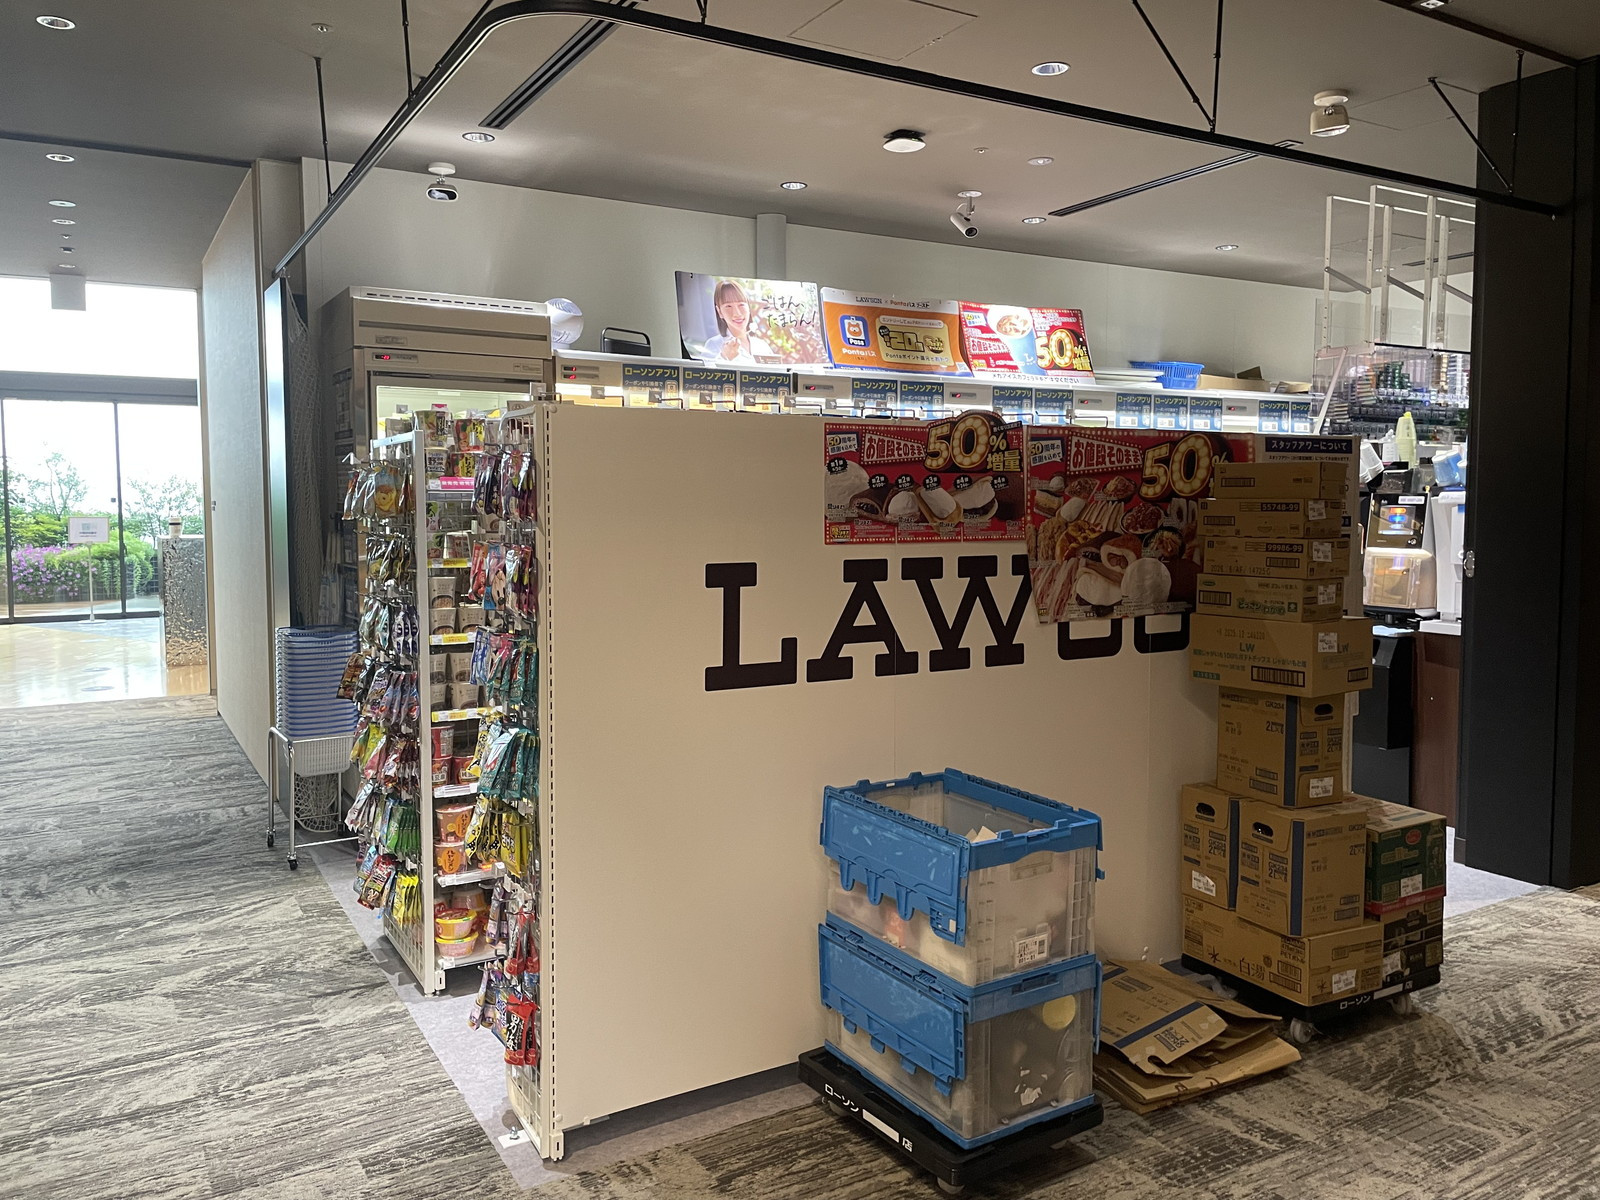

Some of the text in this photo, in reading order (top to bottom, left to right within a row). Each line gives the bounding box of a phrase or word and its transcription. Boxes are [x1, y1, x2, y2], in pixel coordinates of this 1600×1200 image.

[856, 296, 882, 304] LAWSON
[849, 338, 865, 346] Pass
[842, 347, 876, 357] Pontaパス
[625, 367, 678, 378] ローソンアプリ
[685, 371, 735, 382] ローソンアプリ
[741, 375, 790, 385] ローソンアプリ
[924, 414, 1006, 469] 50%
[1271, 440, 1348, 451] スタッフアワーについて
[866, 435, 924, 460] お値段そのまま
[1072, 439, 1142, 468] お値段そのまま
[987, 449, 1021, 471] 増量
[1262, 503, 1299, 511] 55748-99
[1267, 544, 1303, 552] 99986-99
[1239, 642, 1255, 652] LW
[1240, 957, 1265, 981] 白湯
[1340, 995, 1371, 1010] ローソン
[824, 1083, 913, 1152] ローソン 店
